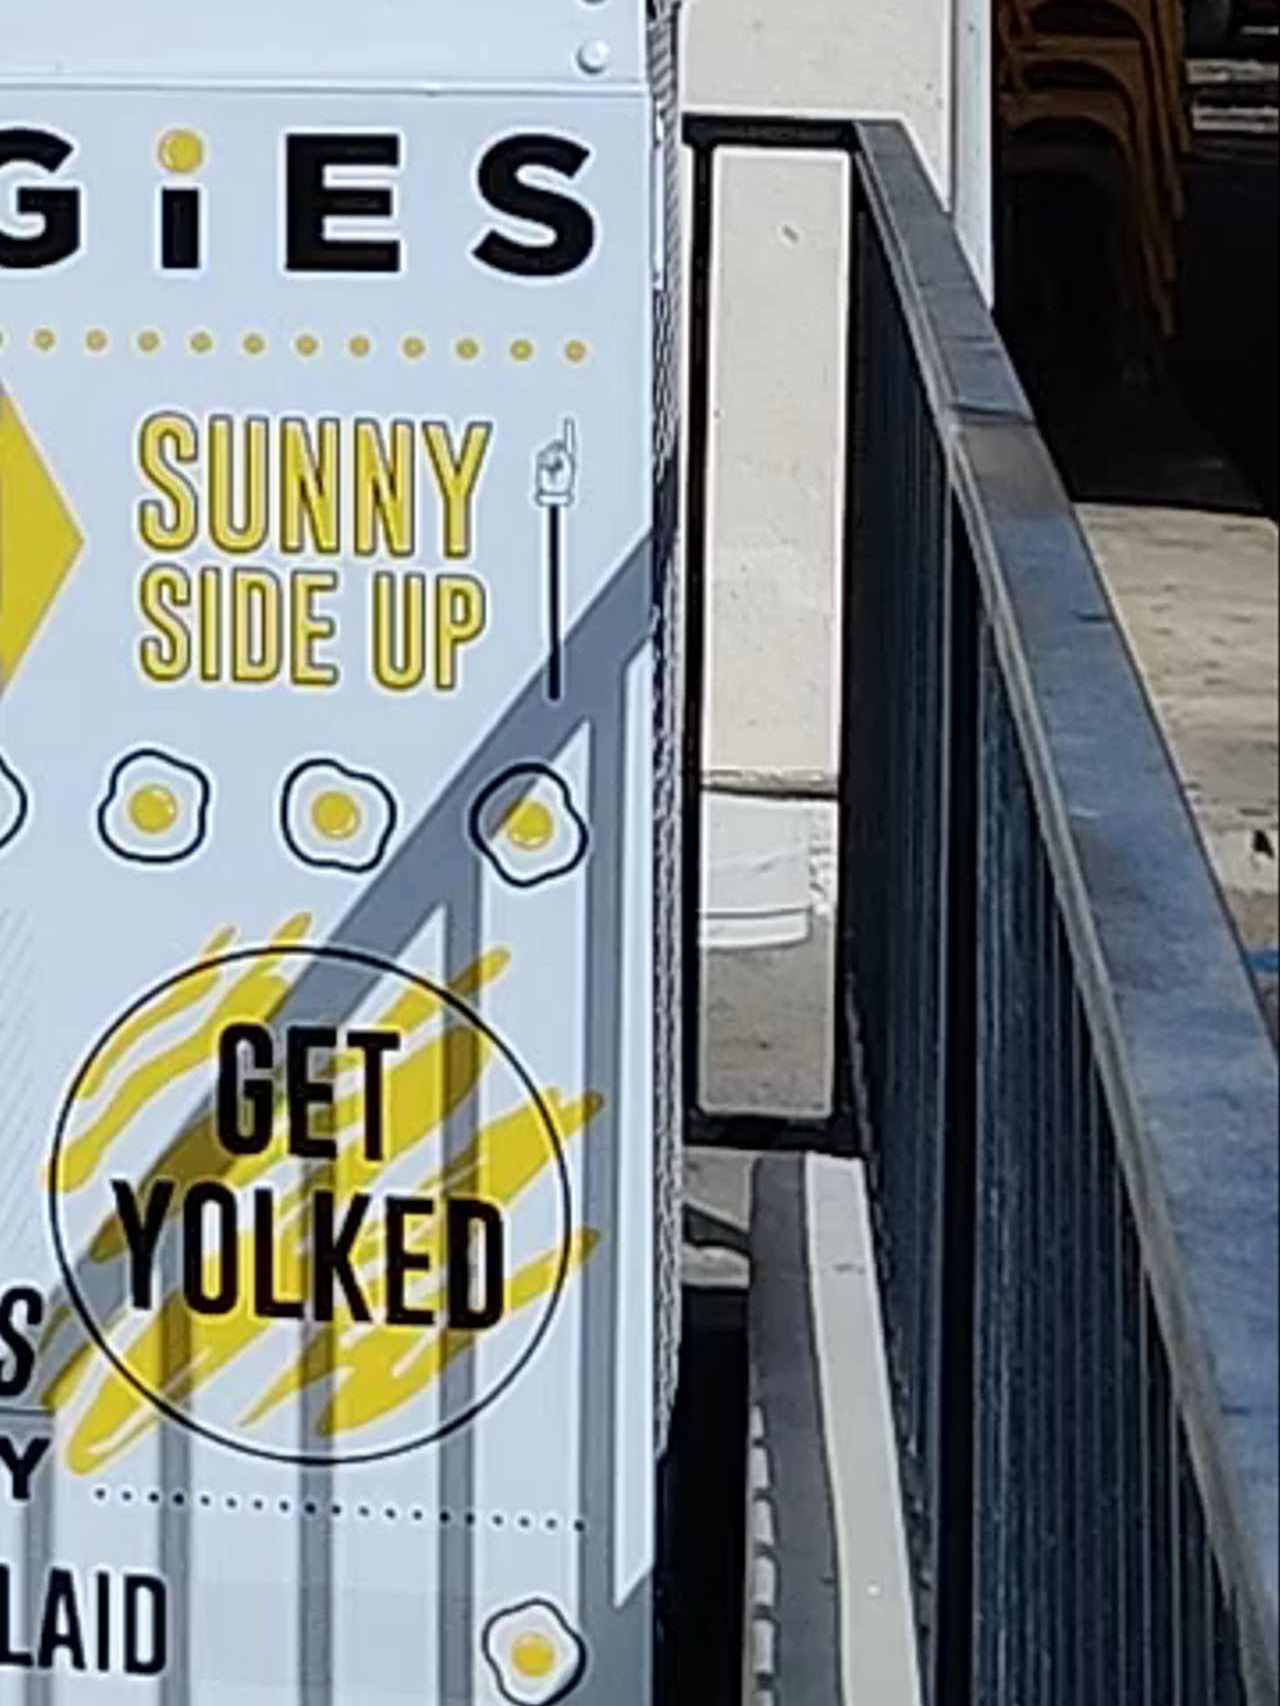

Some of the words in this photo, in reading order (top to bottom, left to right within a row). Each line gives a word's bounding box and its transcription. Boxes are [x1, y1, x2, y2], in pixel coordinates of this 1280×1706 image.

[137, 410, 493, 558] SUNNY
[137, 561, 340, 688] SIDE
[370, 570, 488, 692] UP
[217, 1023, 400, 1162] GET
[110, 1179, 505, 1330] YOLKED
